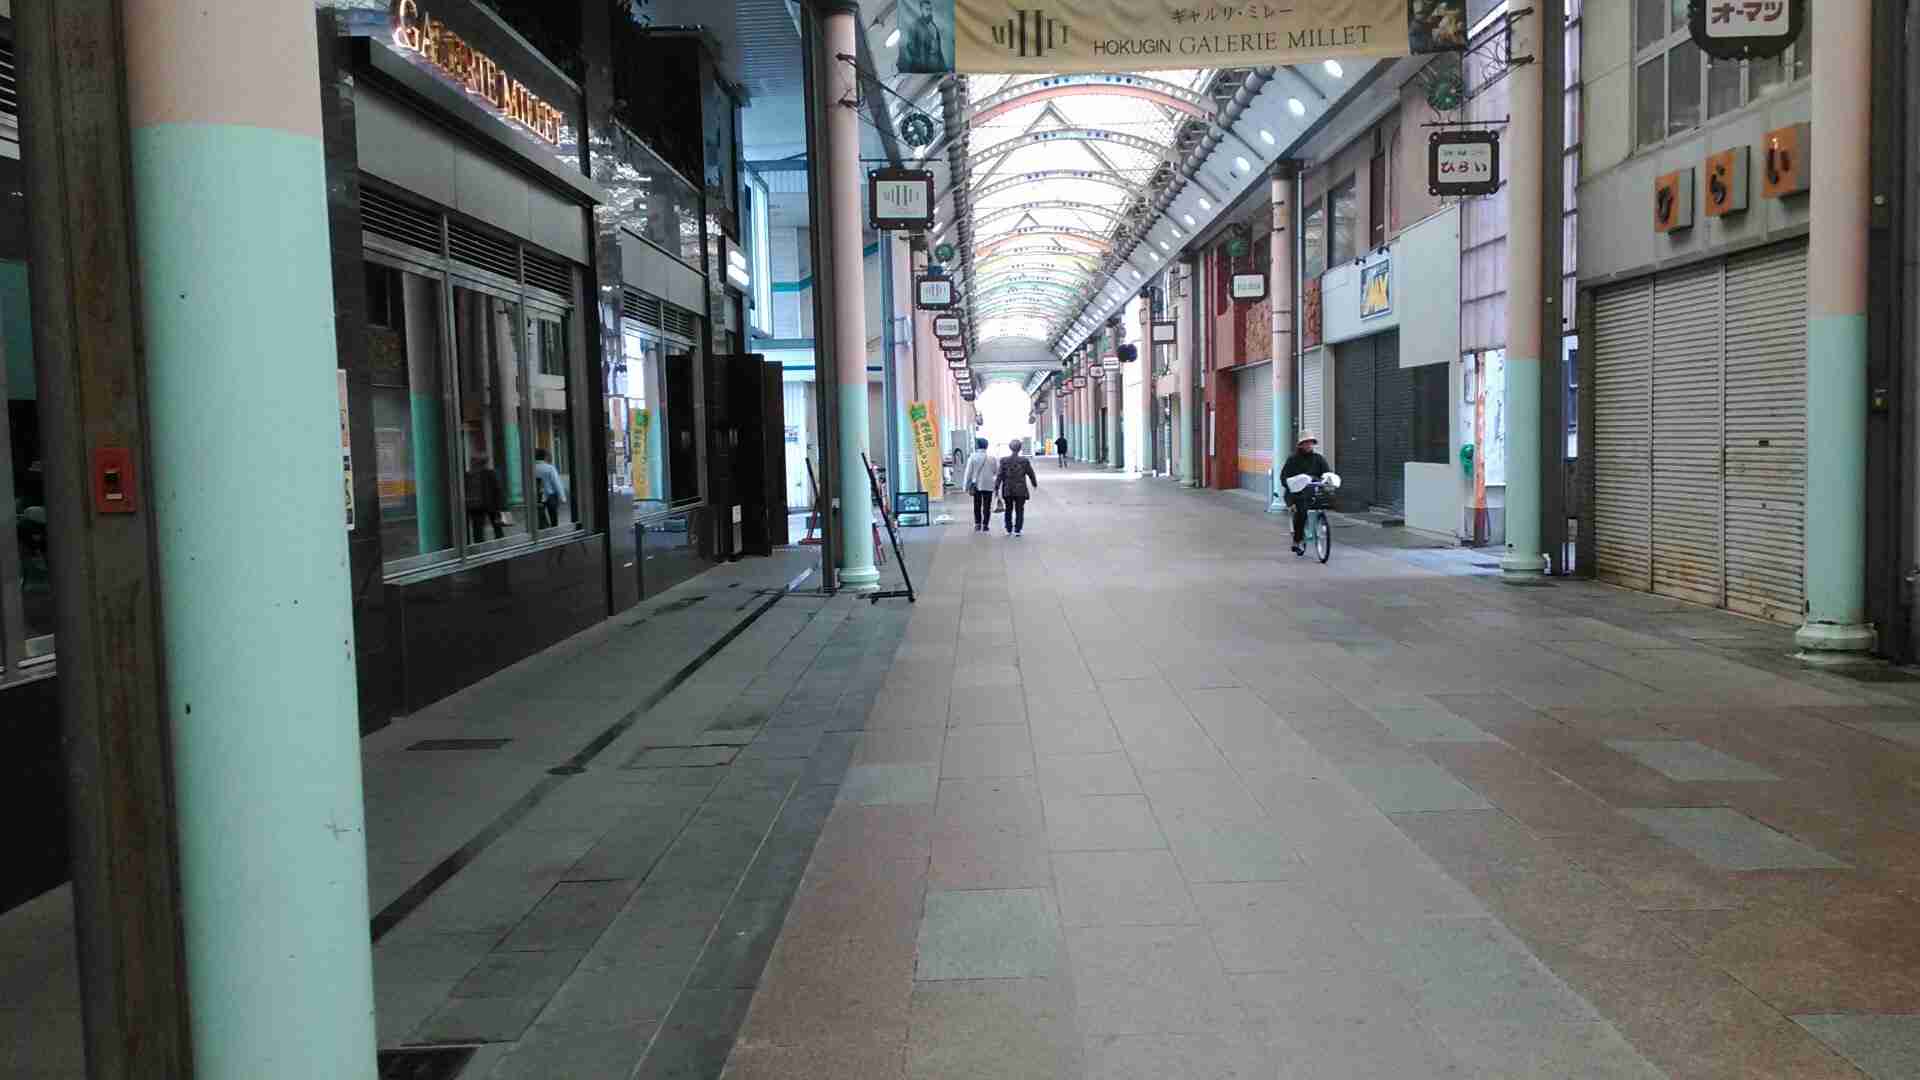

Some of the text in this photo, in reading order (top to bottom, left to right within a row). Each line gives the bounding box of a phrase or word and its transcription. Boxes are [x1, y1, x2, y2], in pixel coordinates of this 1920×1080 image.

[1171, 5, 1294, 24] ギャルリ・ミレー
[1094, 25, 1371, 55] HOKUGIN GALERIE MILLET
[1441, 160, 1488, 174] ひらい
